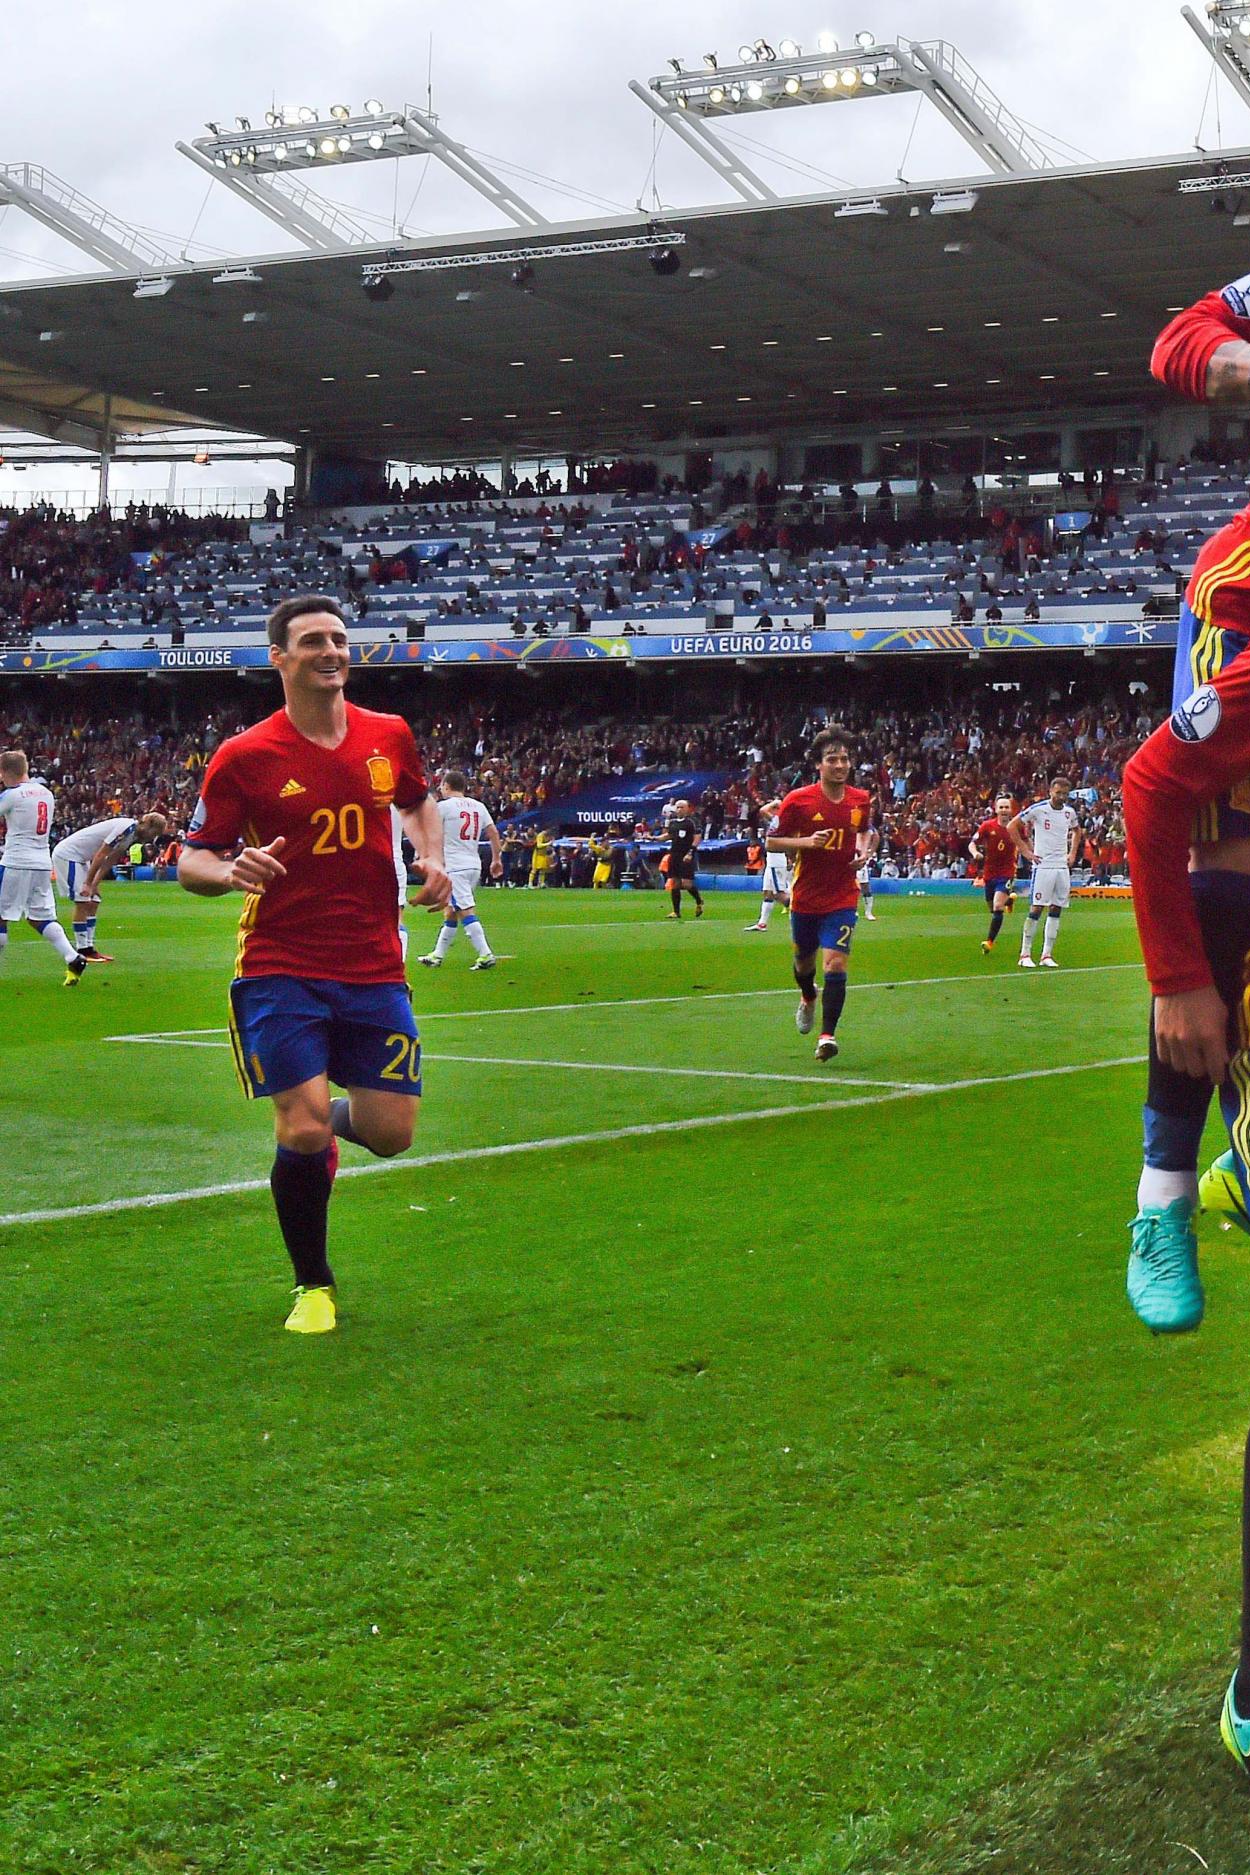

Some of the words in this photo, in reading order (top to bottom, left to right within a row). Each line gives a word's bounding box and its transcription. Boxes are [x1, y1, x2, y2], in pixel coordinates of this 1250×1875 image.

[426, 545, 440, 556] 27
[671, 638, 715, 653] UEFA
[719, 636, 765, 652] EURO
[769, 635, 812, 651] 2016
[159, 651, 232, 666] TOULOUSE
[37, 801, 48, 836] 8
[460, 811, 479, 841] 21
[577, 811, 634, 823] TOULOUSE
[1044, 820, 1051, 830] 6
[310, 803, 365, 855] 20
[824, 828, 845, 850] 21
[998, 839, 1005, 851] 6
[380, 1033, 421, 1083] 20
